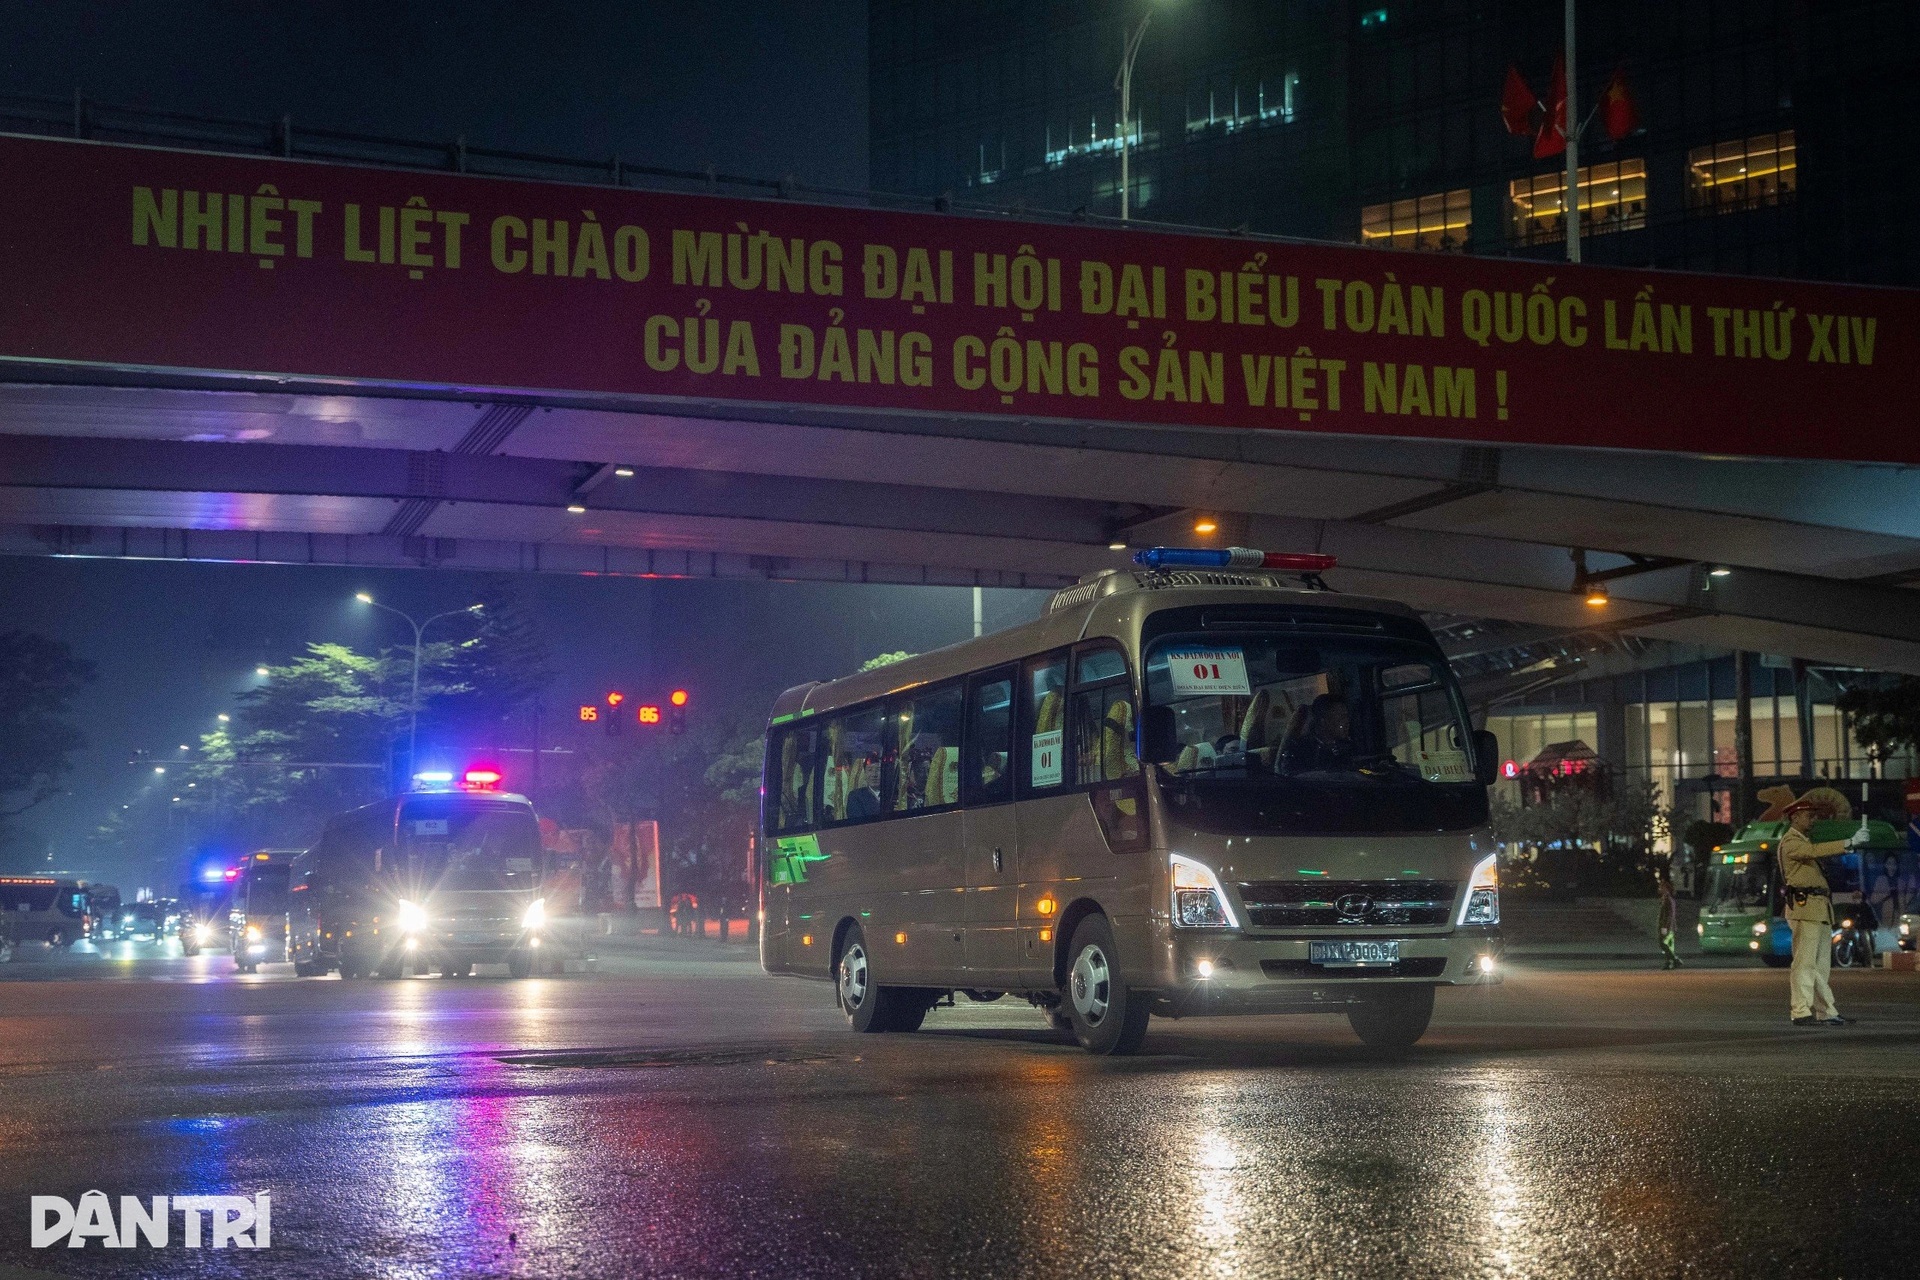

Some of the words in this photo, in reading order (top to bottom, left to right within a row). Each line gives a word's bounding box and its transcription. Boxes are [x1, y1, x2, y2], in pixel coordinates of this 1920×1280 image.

[131, 183, 323, 269] NHIỆT
[344, 195, 470, 280] LIỆT
[490, 209, 650, 282] CHÀO
[671, 221, 843, 296] MỪNG
[862, 244, 954, 315] ĐẠI
[973, 244, 1062, 322] HỘI
[1078, 259, 1167, 329] ĐẠI
[1184, 252, 1300, 328] BIỂU
[1315, 271, 1445, 338] TOÀN
[1461, 276, 1588, 348] QUỐC
[1603, 284, 1693, 355] LẦN
[1706, 300, 1796, 361] THỨ
[1807, 313, 1877, 365] XIV
[643, 299, 760, 376] CỦA
[778, 306, 934, 387] ĐẢNG
[952, 325, 1101, 406] CỘNG
[1117, 330, 1225, 405] SẢN
[1239, 345, 1347, 423] VIỆT
[1362, 360, 1478, 420] NAM
[1494, 369, 1509, 421] !
[1193, 664, 1222, 679] 01
[580, 706, 597, 721] 85
[639, 706, 660, 723] 86
[1041, 751, 1052, 769] 01
